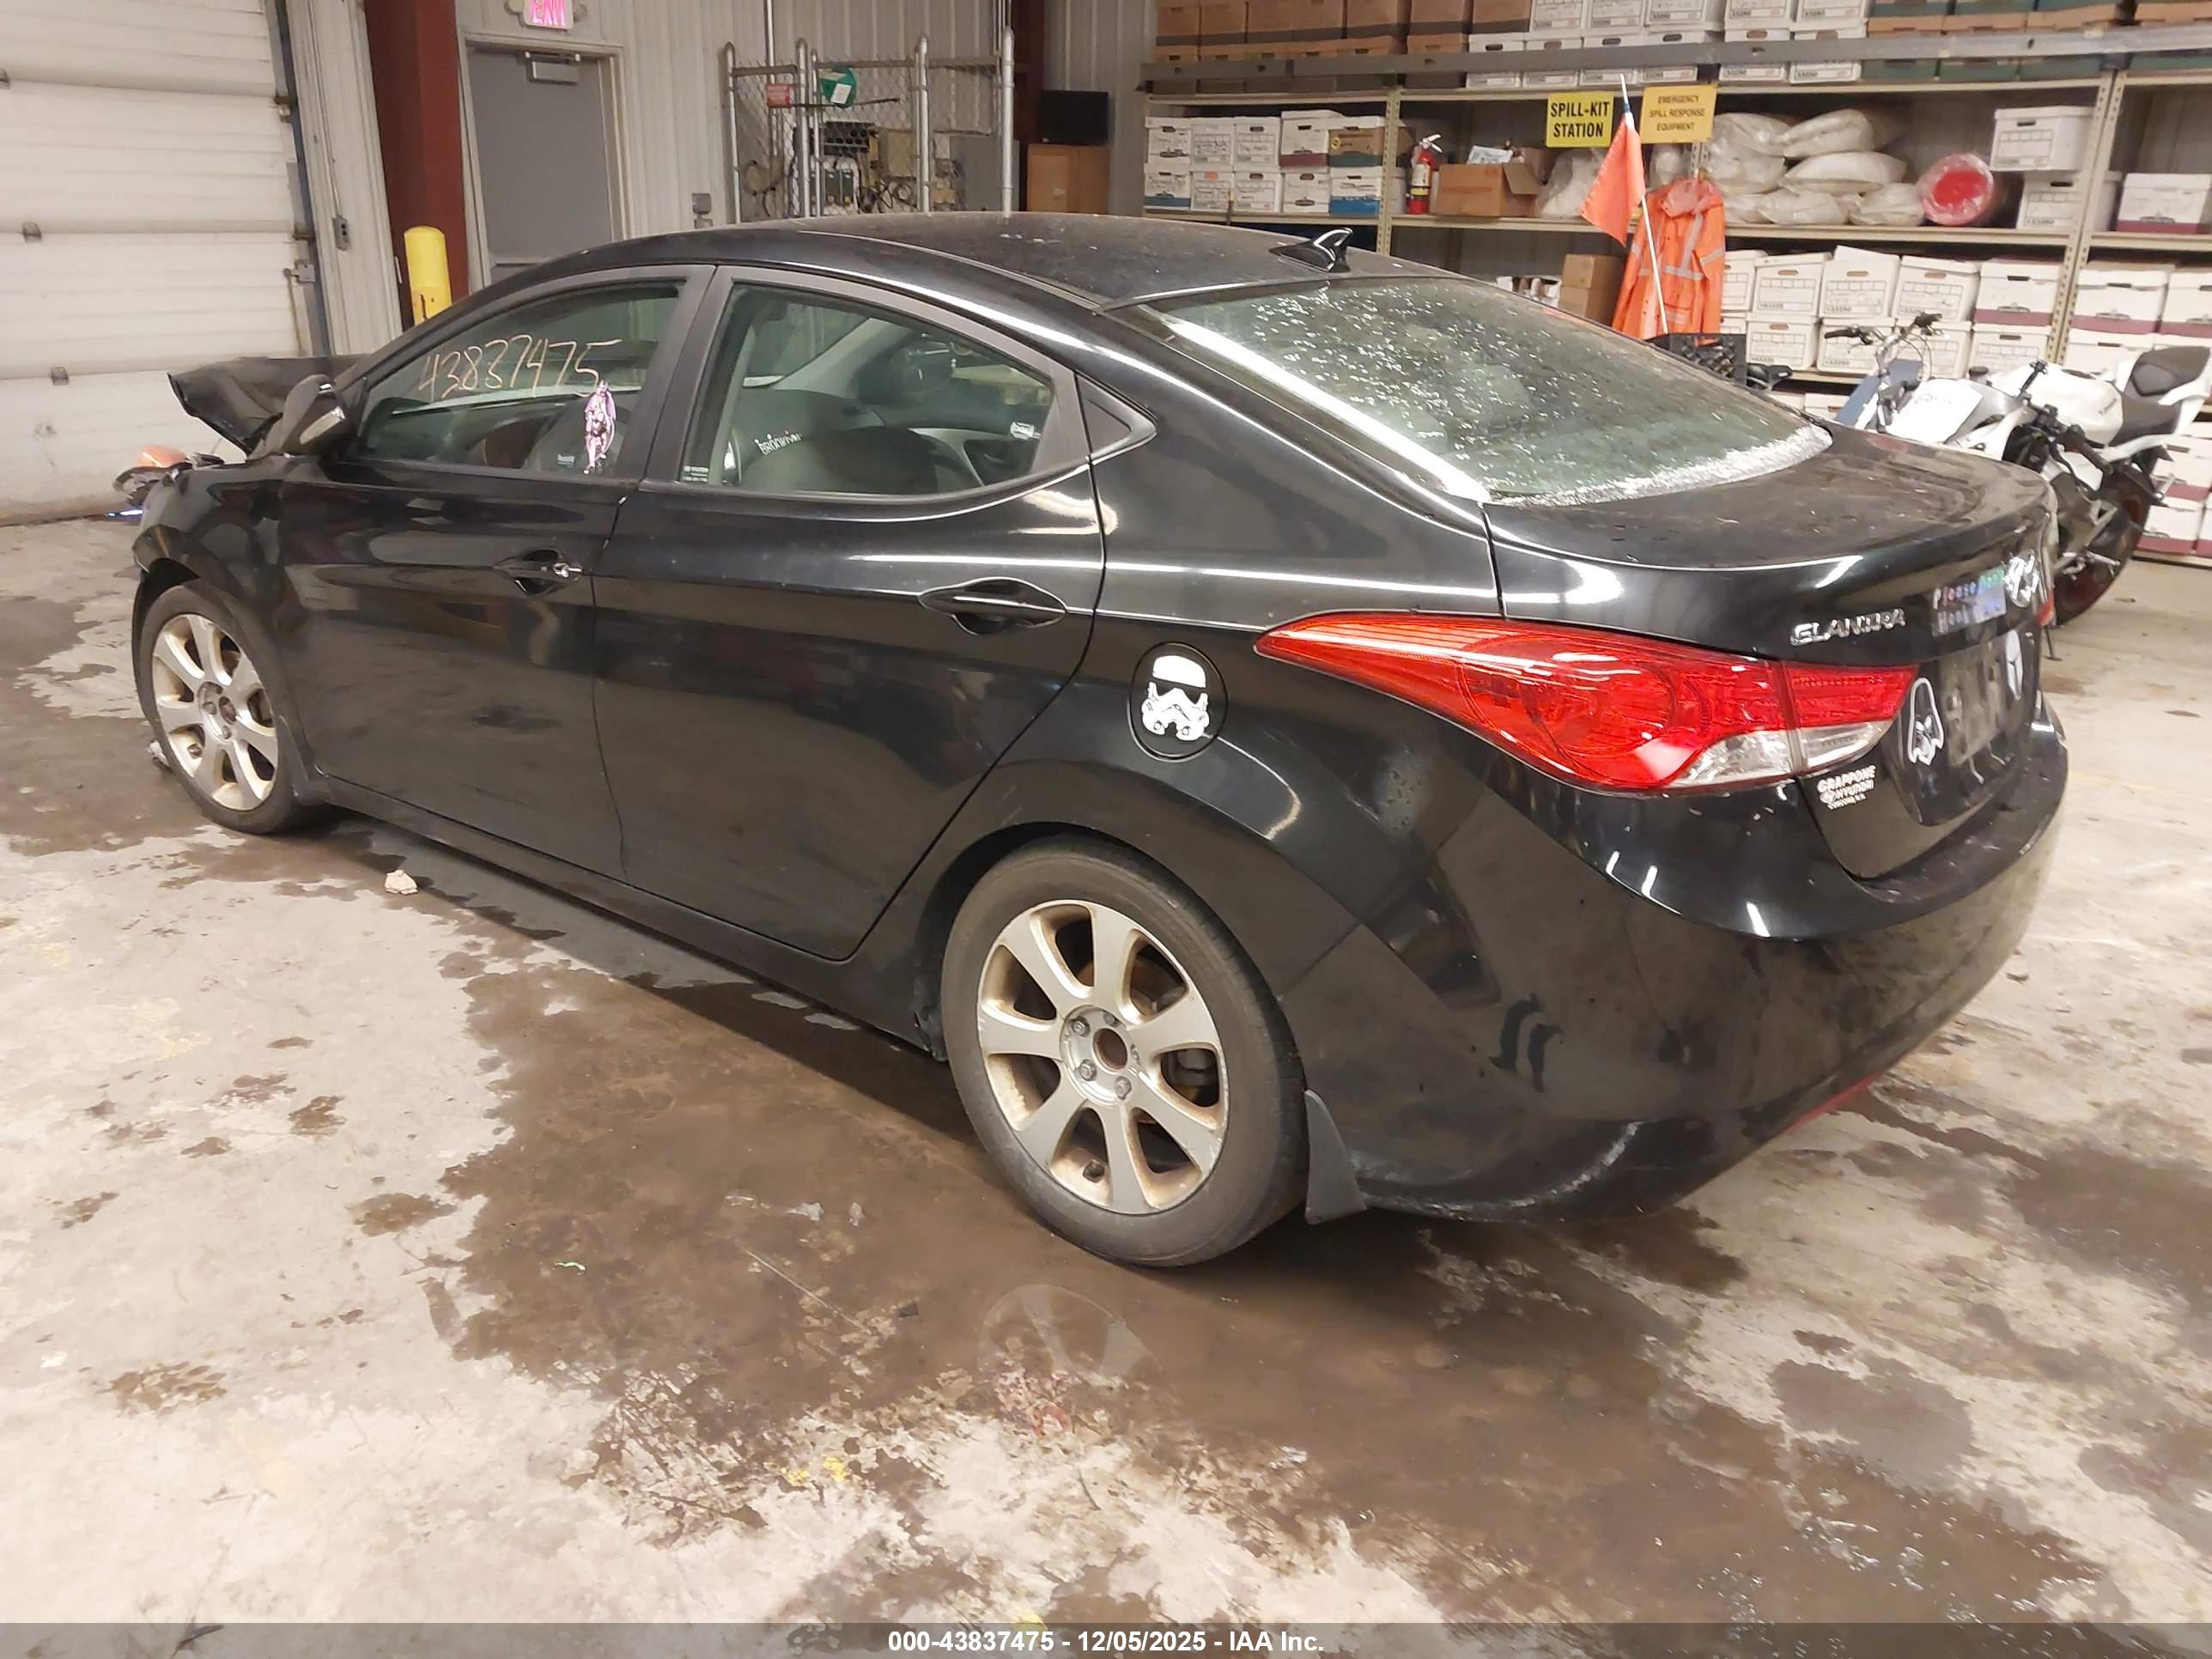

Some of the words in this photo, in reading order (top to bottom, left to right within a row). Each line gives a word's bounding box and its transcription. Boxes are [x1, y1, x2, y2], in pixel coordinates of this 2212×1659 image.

[1657, 94, 1699, 104] EMERGENCY
[1550, 100, 1610, 118] SPILL-KIT
[1649, 109, 1668, 118] SPILL
[1669, 107, 1705, 118] RESPONSE
[1553, 122, 1604, 138] STATION
[1656, 122, 1695, 131] EQUIPMENT
[418, 333, 623, 403] 43837475
[1790, 608, 1906, 647] ELANTRA
